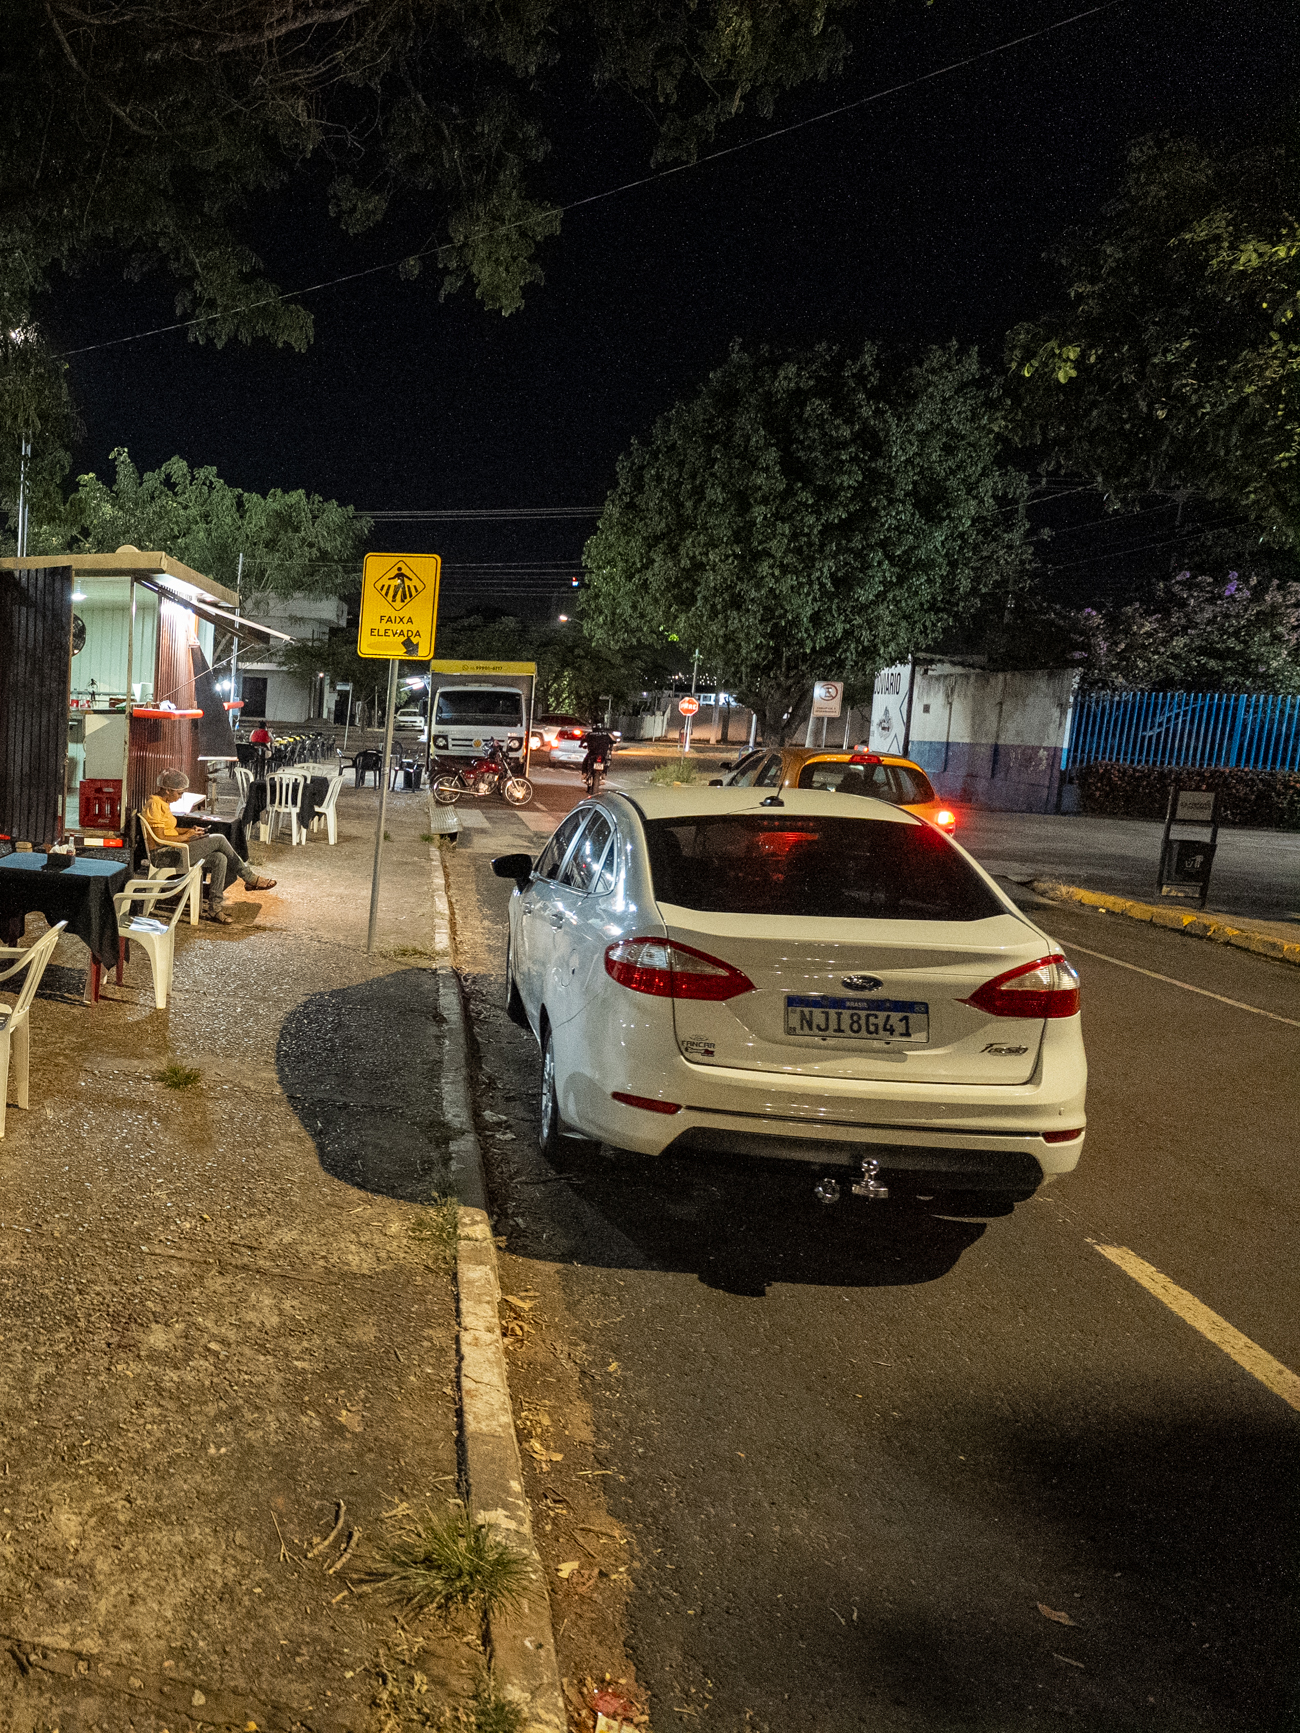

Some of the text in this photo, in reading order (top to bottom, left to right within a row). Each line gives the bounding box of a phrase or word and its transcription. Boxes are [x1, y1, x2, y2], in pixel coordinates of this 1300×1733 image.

[380, 616, 413, 625] FAIXA
[370, 628, 422, 638] ELEVADA
[800, 1010, 912, 1037] NJI8G41
